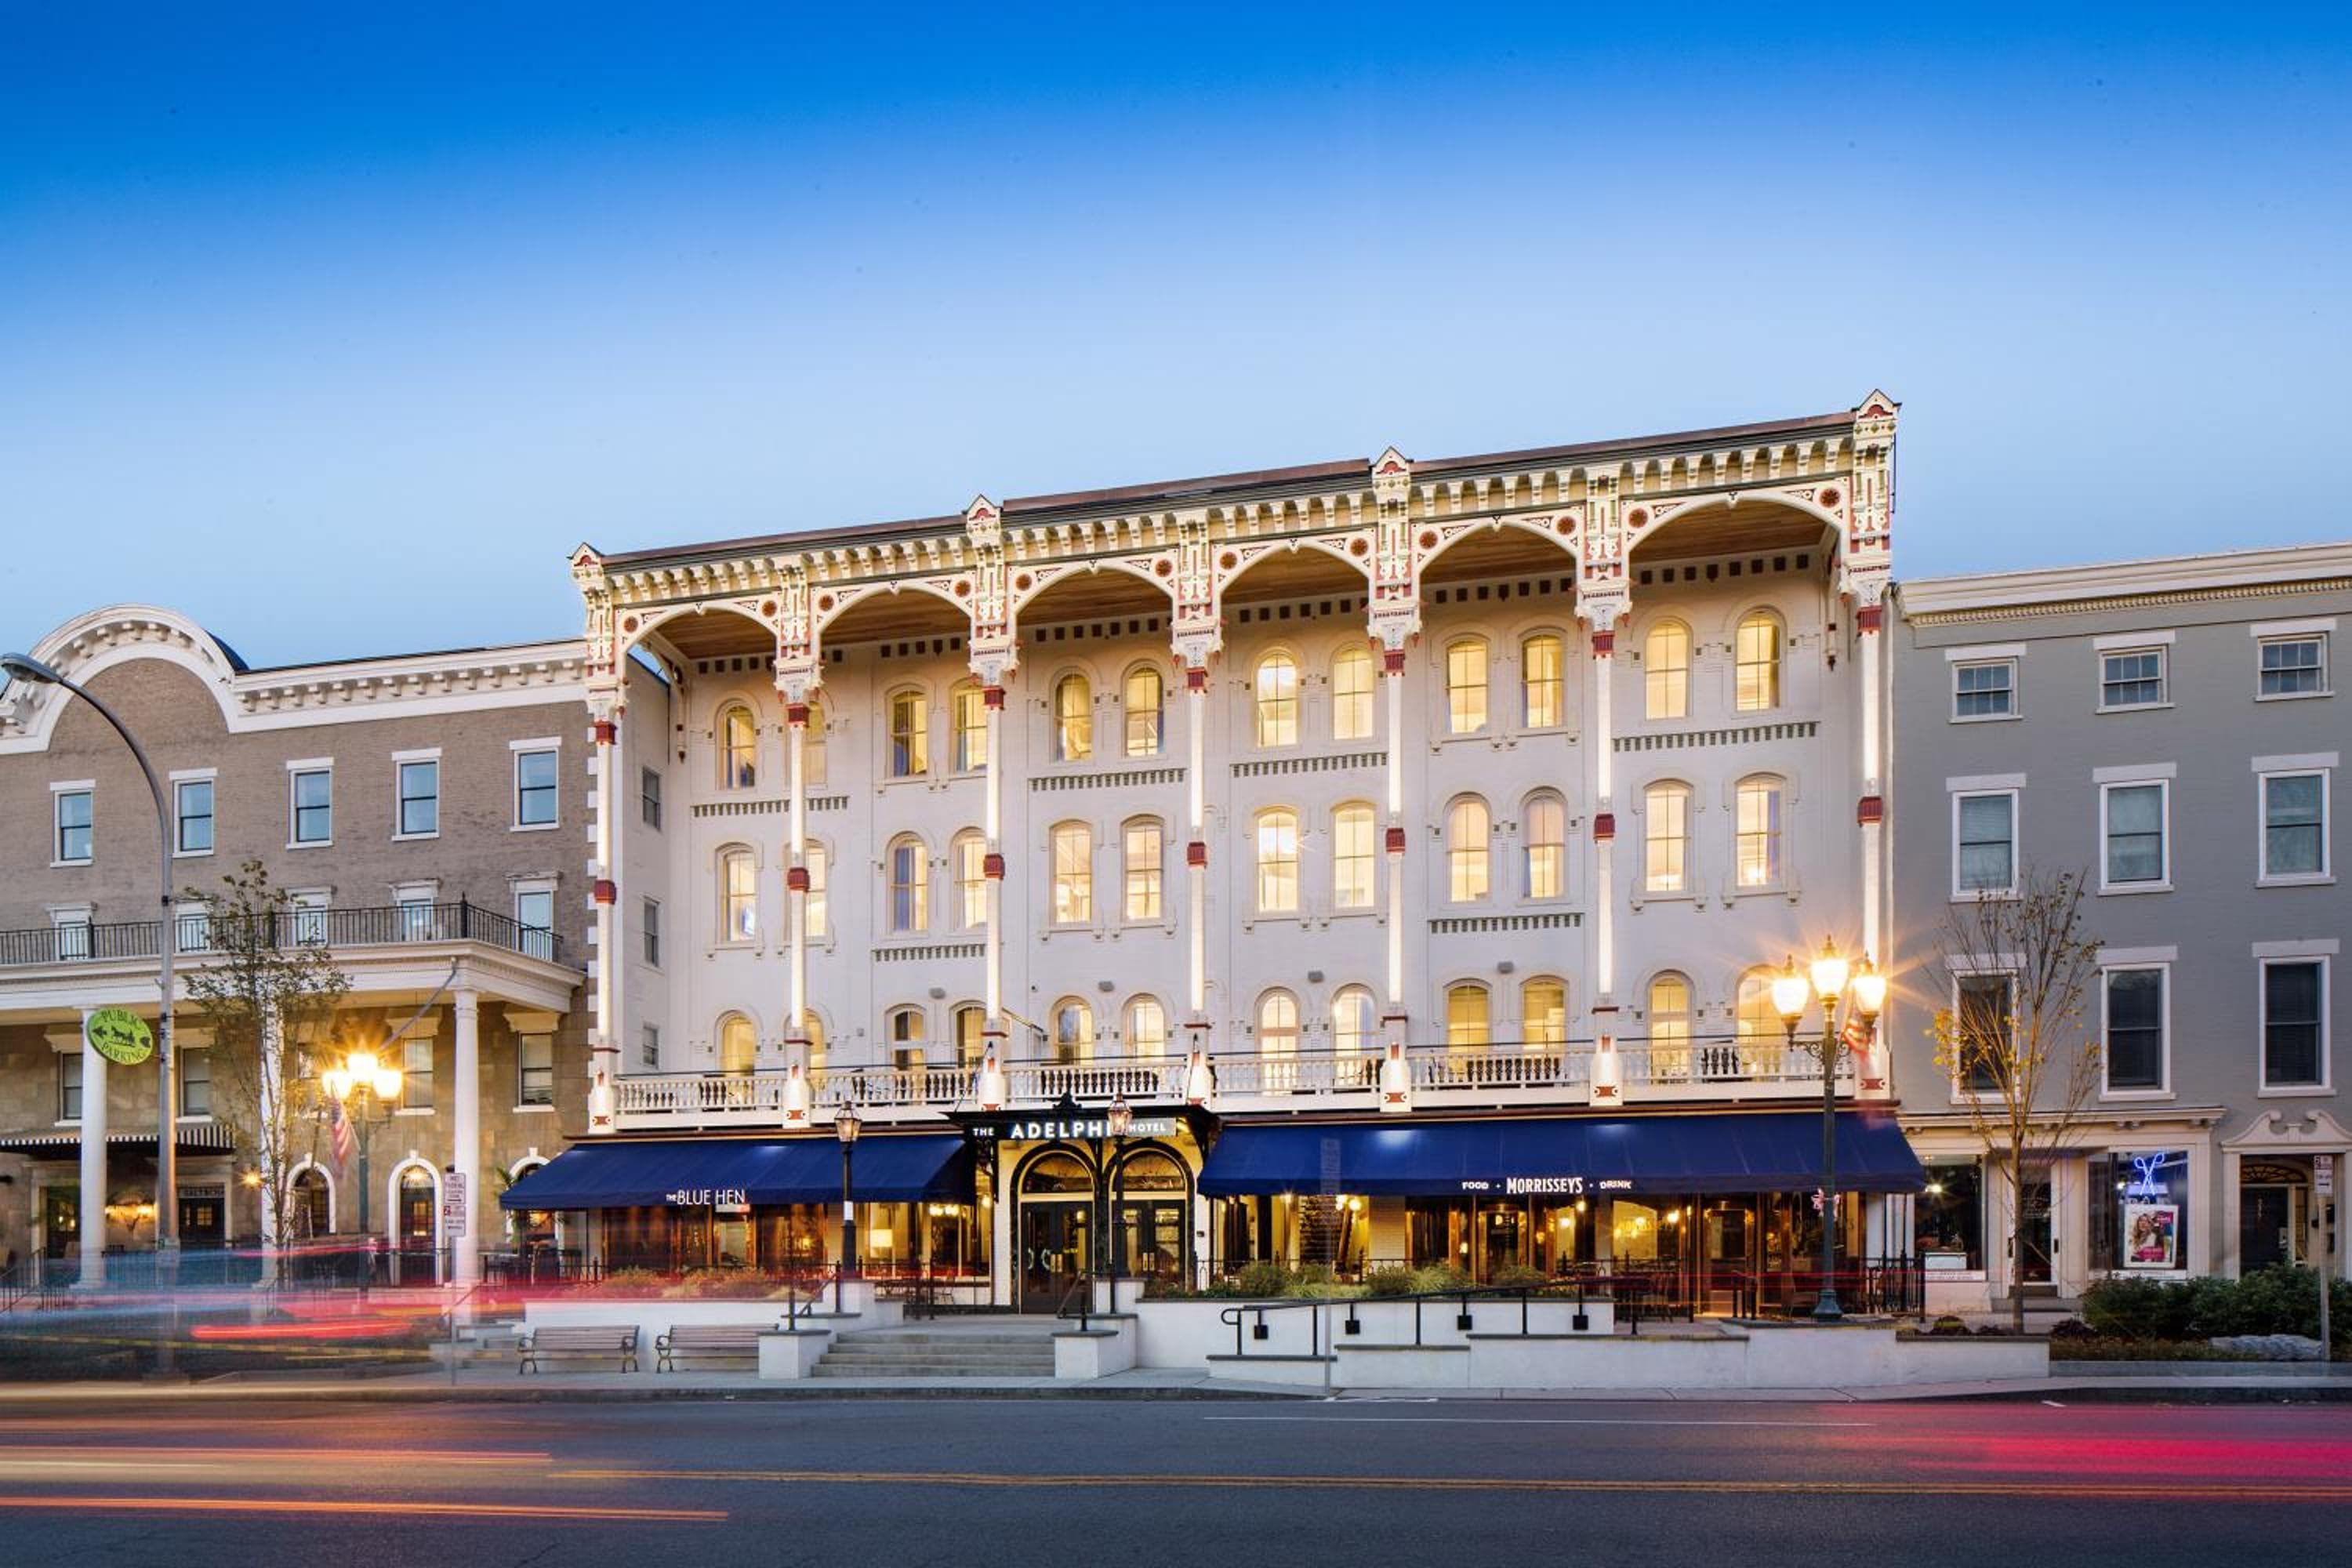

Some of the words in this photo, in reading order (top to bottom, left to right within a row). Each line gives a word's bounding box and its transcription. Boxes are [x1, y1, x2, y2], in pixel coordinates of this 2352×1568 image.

[100, 1009, 142, 1030] PUBLIC
[101, 1042, 147, 1062] PARKING
[973, 1127, 994, 1136] THE
[1128, 1123, 1166, 1132] HOTEL
[1462, 1181, 1489, 1190] FOOD
[1599, 1180, 1632, 1189] DRINK
[677, 1189, 711, 1205] BLUE
[715, 1189, 745, 1204] HEN
